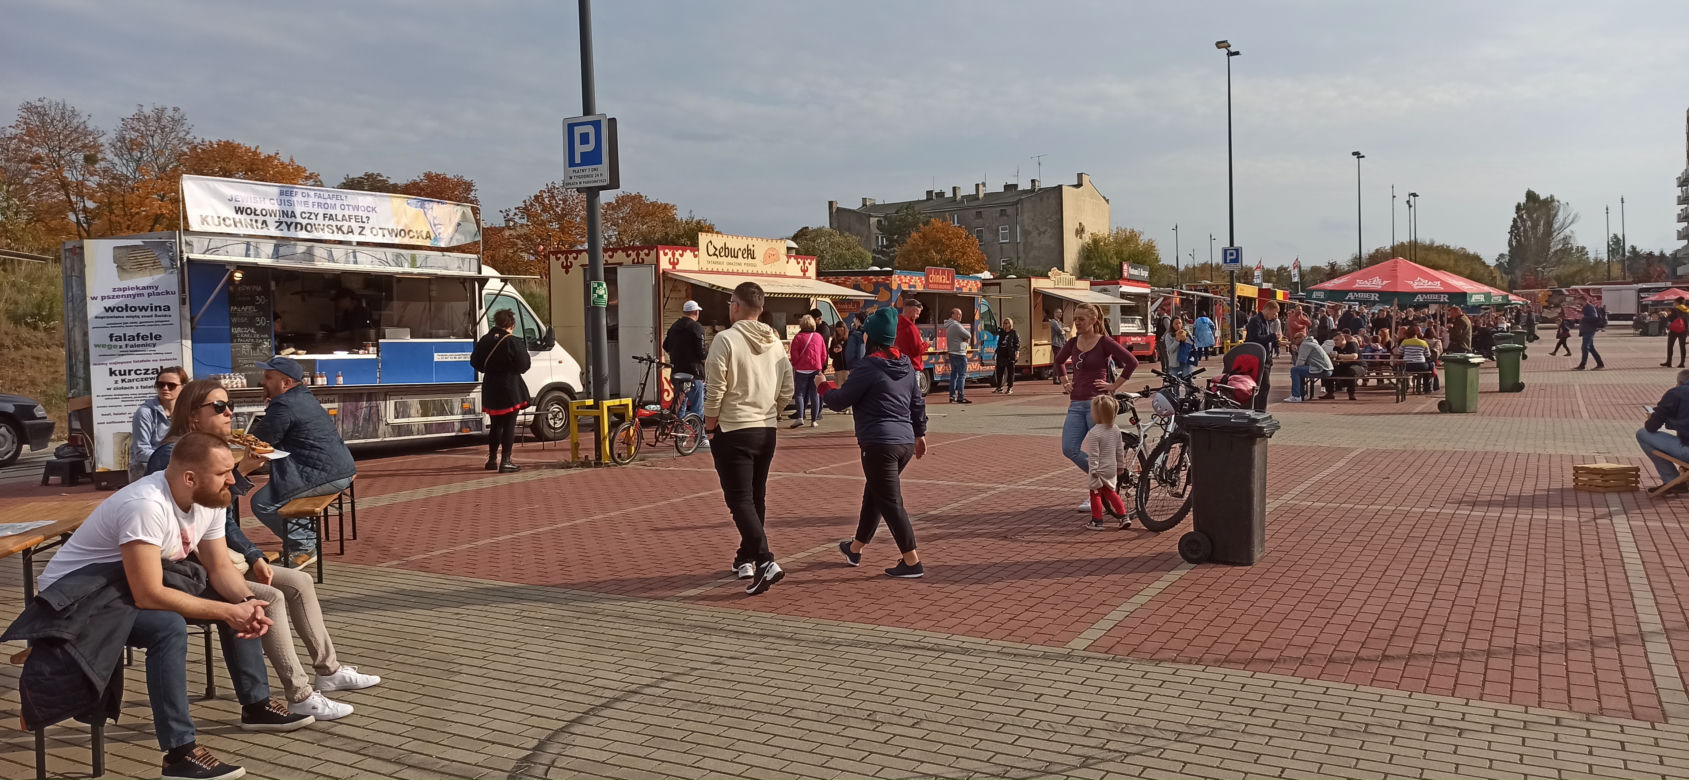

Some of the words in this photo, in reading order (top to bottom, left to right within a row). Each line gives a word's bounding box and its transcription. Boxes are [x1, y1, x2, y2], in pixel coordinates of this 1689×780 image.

[574, 125, 596, 164] P
[280, 189, 299, 198] BEEF
[313, 192, 348, 201] FALAFEL?
[269, 198, 310, 208] CUISINE
[312, 202, 337, 210] FROM
[340, 204, 378, 214] OTWOCK
[234, 206, 297, 220] WOŁOWINA
[300, 211, 319, 221] CZY
[323, 212, 370, 224] FALAFEL?
[200, 214, 270, 230] KUCHNIA
[274, 218, 354, 236] ŻYDOWSKA
[358, 226, 366, 236] Z
[370, 226, 432, 240] OTWOCKA
[706, 240, 756, 260] Czebureki
[1226, 250, 1236, 263] P
[112, 285, 159, 293] zapiekamy
[101, 292, 144, 301] pszennym
[148, 290, 176, 298] placku
[1345, 292, 1380, 300] AMBER
[1414, 294, 1449, 302] AMBER
[104, 303, 171, 313] wołowina
[108, 332, 162, 342] falafele
